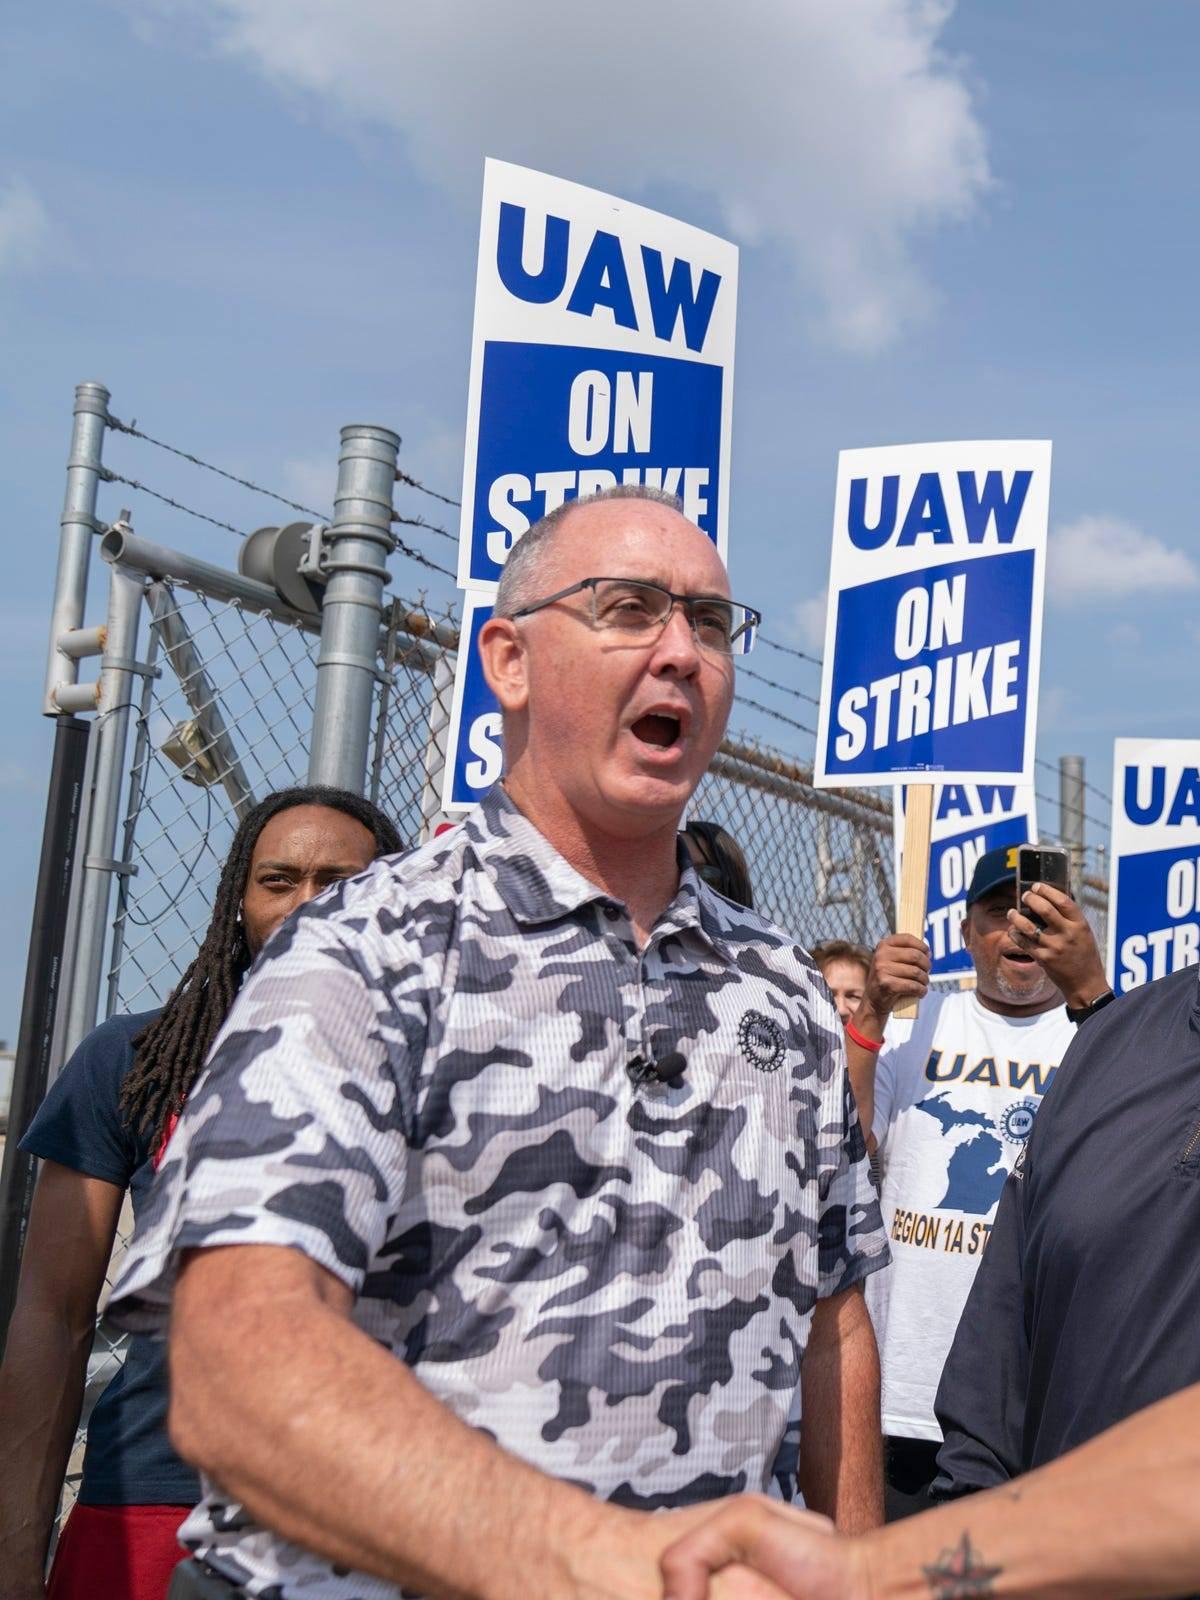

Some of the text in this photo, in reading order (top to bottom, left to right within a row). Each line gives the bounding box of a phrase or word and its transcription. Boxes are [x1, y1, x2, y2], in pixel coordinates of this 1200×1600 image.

[496, 201, 722, 353] UAW
[568, 369, 653, 456] ON
[848, 470, 1034, 550] UAW
[894, 574, 967, 660] ON
[835, 640, 1020, 762] STRIKE
[925, 1049, 1059, 1096] UAW
[1011, 1118, 1029, 1127] UAW
[892, 1208, 941, 1250] REGION
[944, 1219, 964, 1253] 1A
